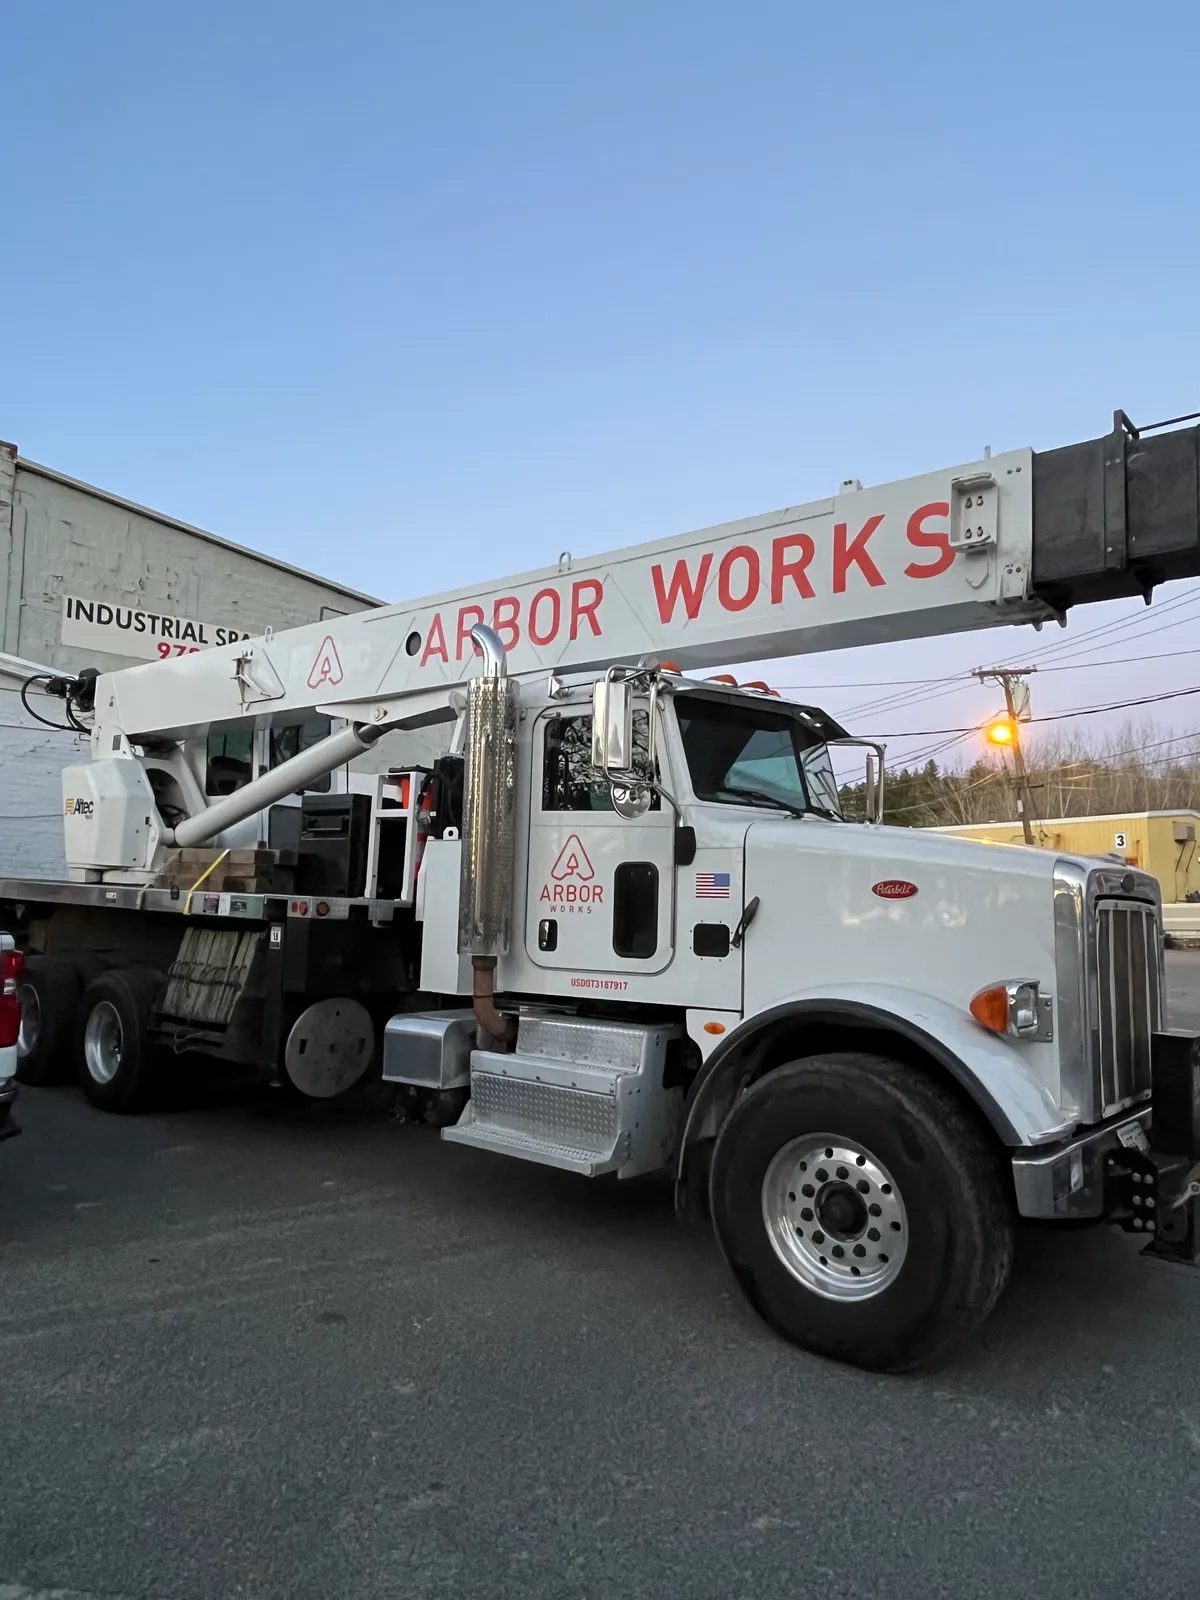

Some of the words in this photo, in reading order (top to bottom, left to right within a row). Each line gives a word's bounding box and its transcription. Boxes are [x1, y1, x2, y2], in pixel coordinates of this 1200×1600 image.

[420, 578, 604, 667] ARBOR
[651, 502, 957, 625] WORKS
[66, 598, 209, 645] INDUSTRIAL
[1116, 834, 1125, 847] 3
[539, 884, 604, 903] ARBOR
[876, 882, 914, 895] Peterbilt
[549, 904, 592, 914] WORKS
